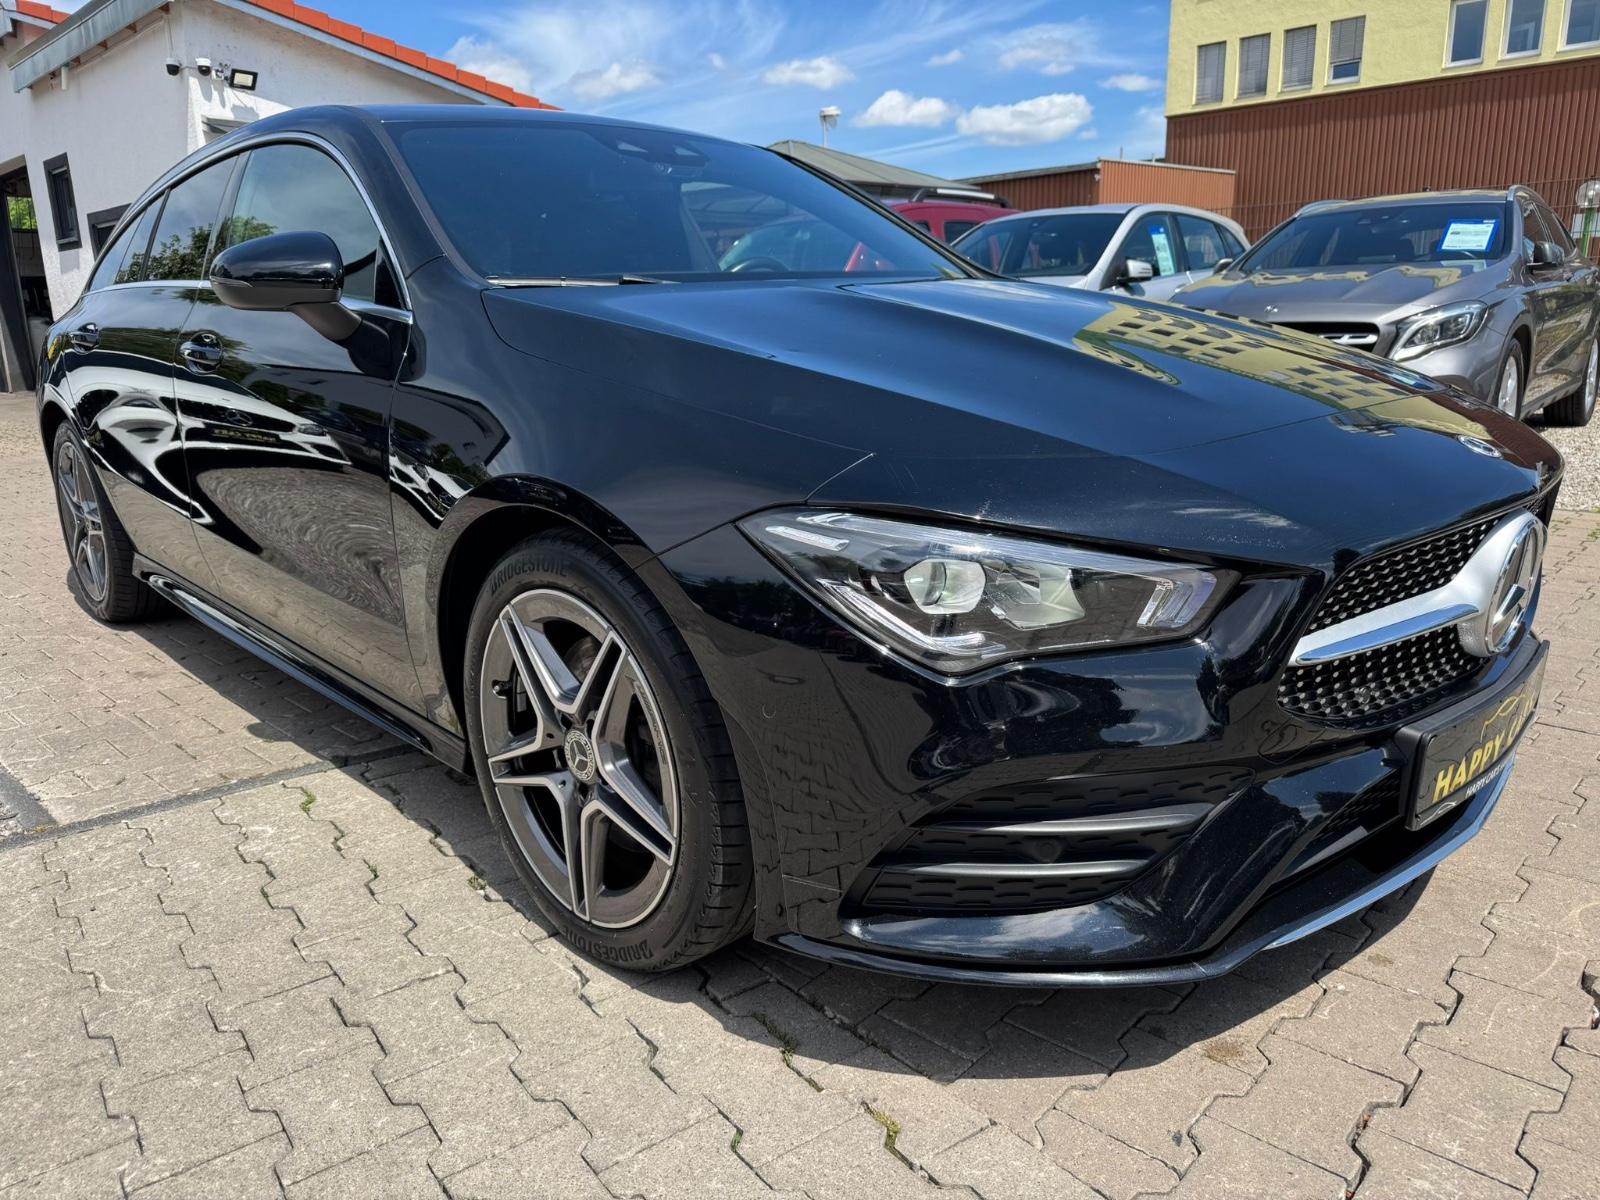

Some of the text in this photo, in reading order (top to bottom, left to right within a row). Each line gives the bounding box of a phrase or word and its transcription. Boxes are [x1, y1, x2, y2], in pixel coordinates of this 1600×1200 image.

[490, 557, 568, 596] BRIDGESTONE
[1432, 729, 1506, 803] HAPPY
[561, 926, 655, 962] BRIDGESTONE
